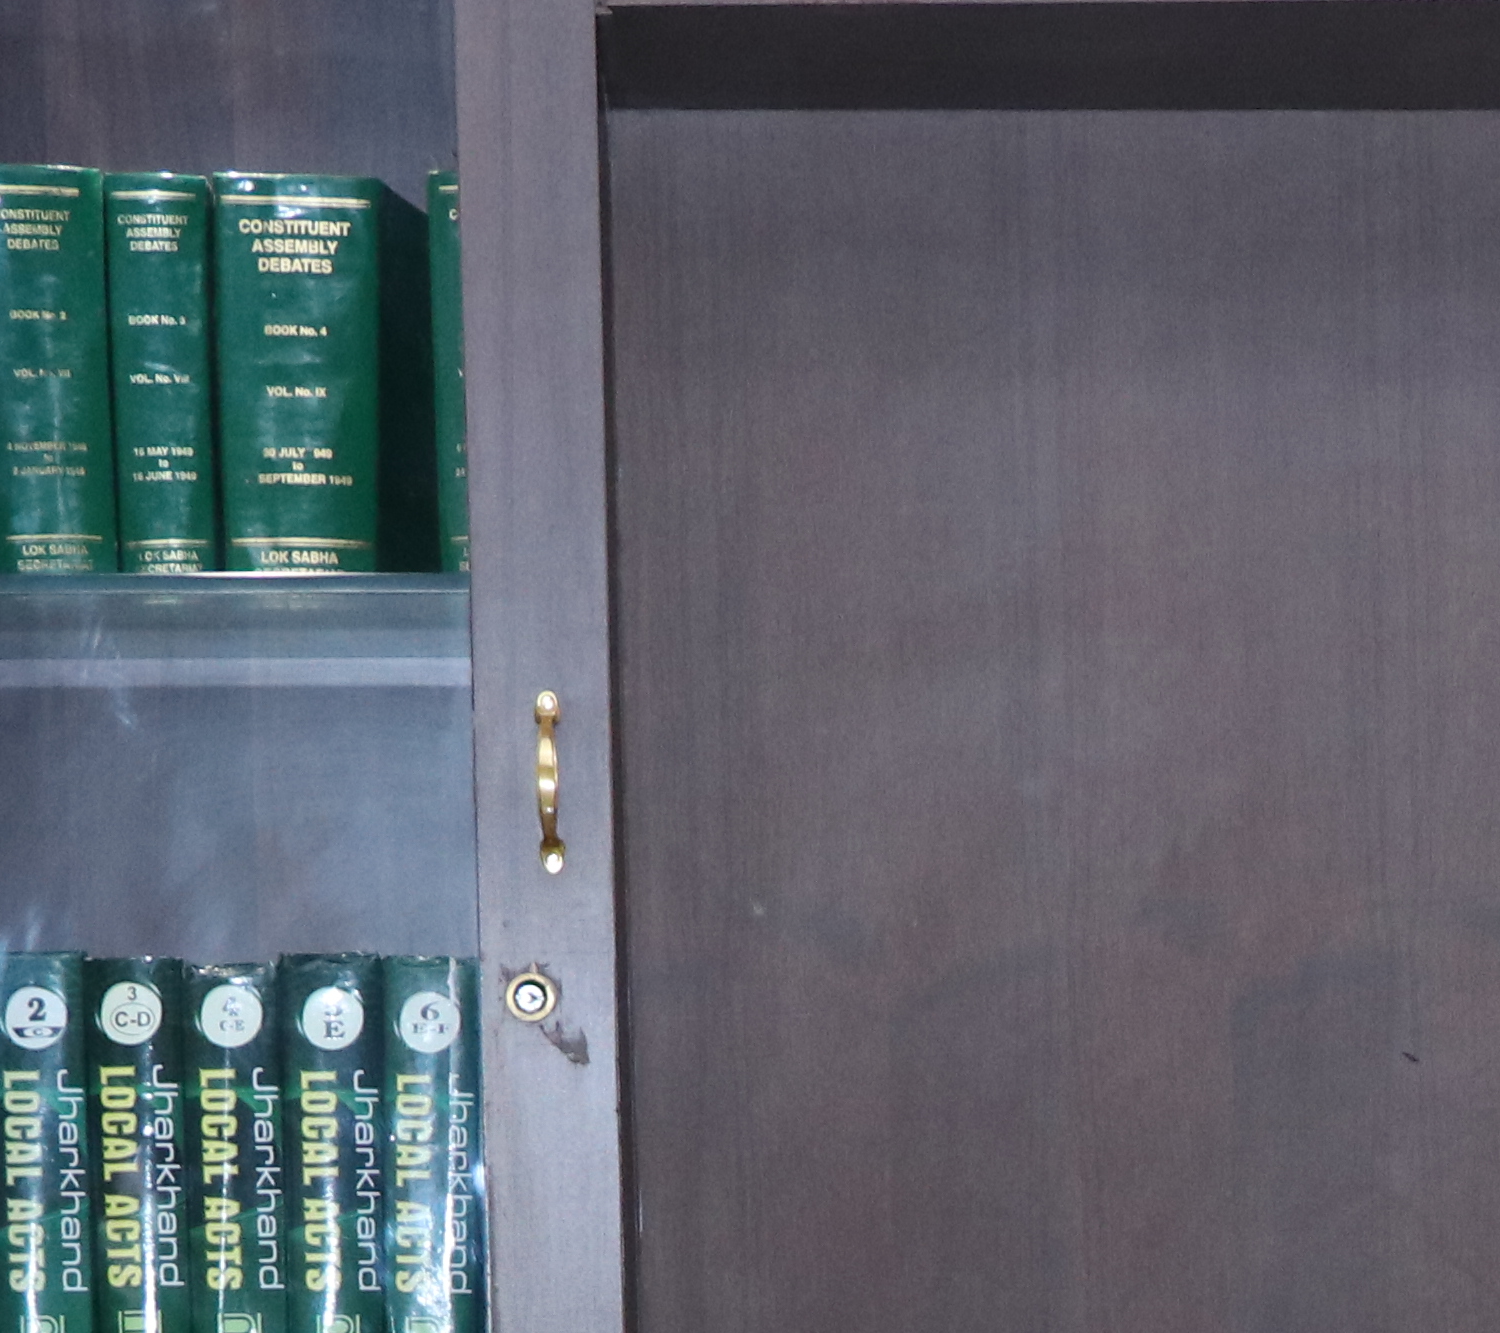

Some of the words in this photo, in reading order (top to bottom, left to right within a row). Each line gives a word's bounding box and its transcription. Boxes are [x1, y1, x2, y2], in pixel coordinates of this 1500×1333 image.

[117, 214, 188, 225] CONSTITUENT
[238, 218, 351, 236] CONSTITUENT
[2, 223, 63, 235] ASSEMBLY
[126, 227, 181, 238] ASSEMBLY
[7, 238, 60, 250] DEBATES
[130, 240, 178, 251] DEBATES
[251, 238, 338, 255] ASSEMBLY
[258, 257, 333, 274] DEBATES
[128, 315, 159, 326] BOOK
[264, 324, 298, 336] BOOK
[299, 326, 318, 336] No.
[319, 326, 328, 336] 4
[130, 373, 153, 384] VOL.
[266, 385, 292, 397] VOL.
[295, 387, 311, 397] No.
[315, 387, 327, 397] IX
[147, 446, 169, 456] MAY
[279, 447, 306, 458] JULY
[292, 461, 304, 471] to
[145, 471, 173, 480] JUNE
[258, 473, 326, 485] SEPTEMBER
[22, 544, 46, 556] LOK
[162, 550, 199, 561] SABHA
[261, 551, 288, 563] LOK
[291, 551, 339, 564] SABHA
[127, 986, 137, 1000] 3
[28, 997, 46, 1021] 2
[421, 1001, 440, 1021] 6
[115, 1011, 151, 1027] C-D
[324, 1021, 345, 1039] E
[3, 1069, 43, 1186] LOCAL
[100, 1064, 139, 1182] LOCAL
[199, 1067, 240, 1185] LOCAL
[300, 1069, 340, 1186] LOCAL
[395, 1073, 433, 1187] LOCAL
[56, 1069, 89, 1292] Jharkhand
[152, 1064, 185, 1287] Jharkhand
[252, 1067, 285, 1290] Jharkhand
[353, 1068, 382, 1292] Jharkhand
[449, 1072, 475, 1295] Jharkhand
[7, 1197, 46, 1293] ACTS
[104, 1193, 143, 1289] ACTS
[203, 1195, 243, 1291] ACTS
[303, 1197, 343, 1292] ACTS
[395, 1200, 434, 1294] ACTS
